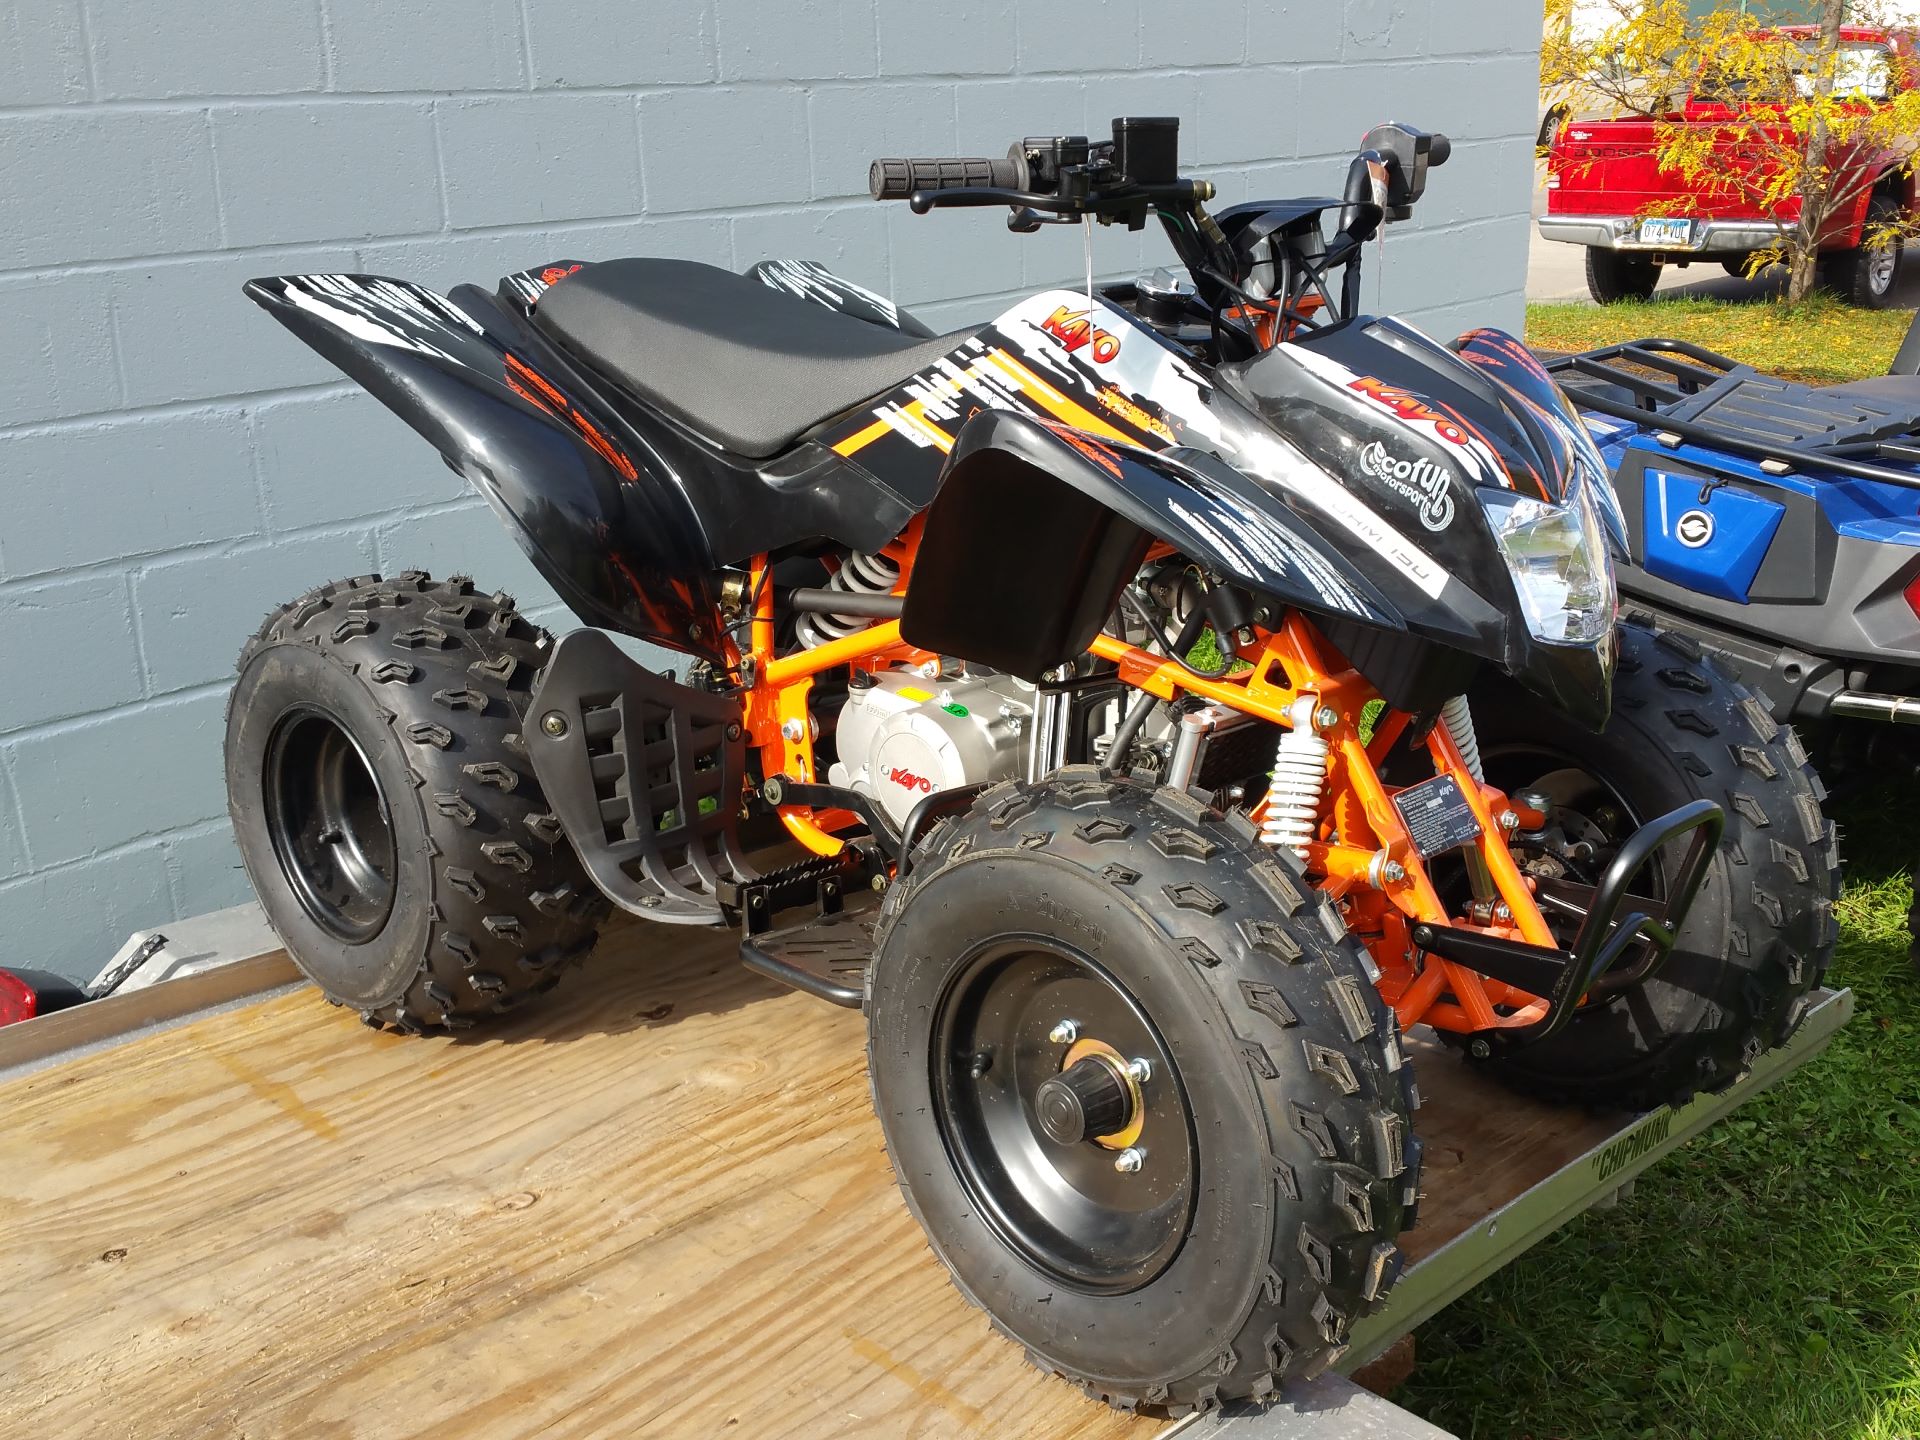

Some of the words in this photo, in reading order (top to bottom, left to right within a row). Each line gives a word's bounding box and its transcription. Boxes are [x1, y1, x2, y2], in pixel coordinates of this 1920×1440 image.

[1040, 305, 1121, 364] KAYO
[1346, 375, 1470, 446] KAYO
[1373, 464, 1432, 517] motorsports
[889, 767, 931, 794] KAYO
